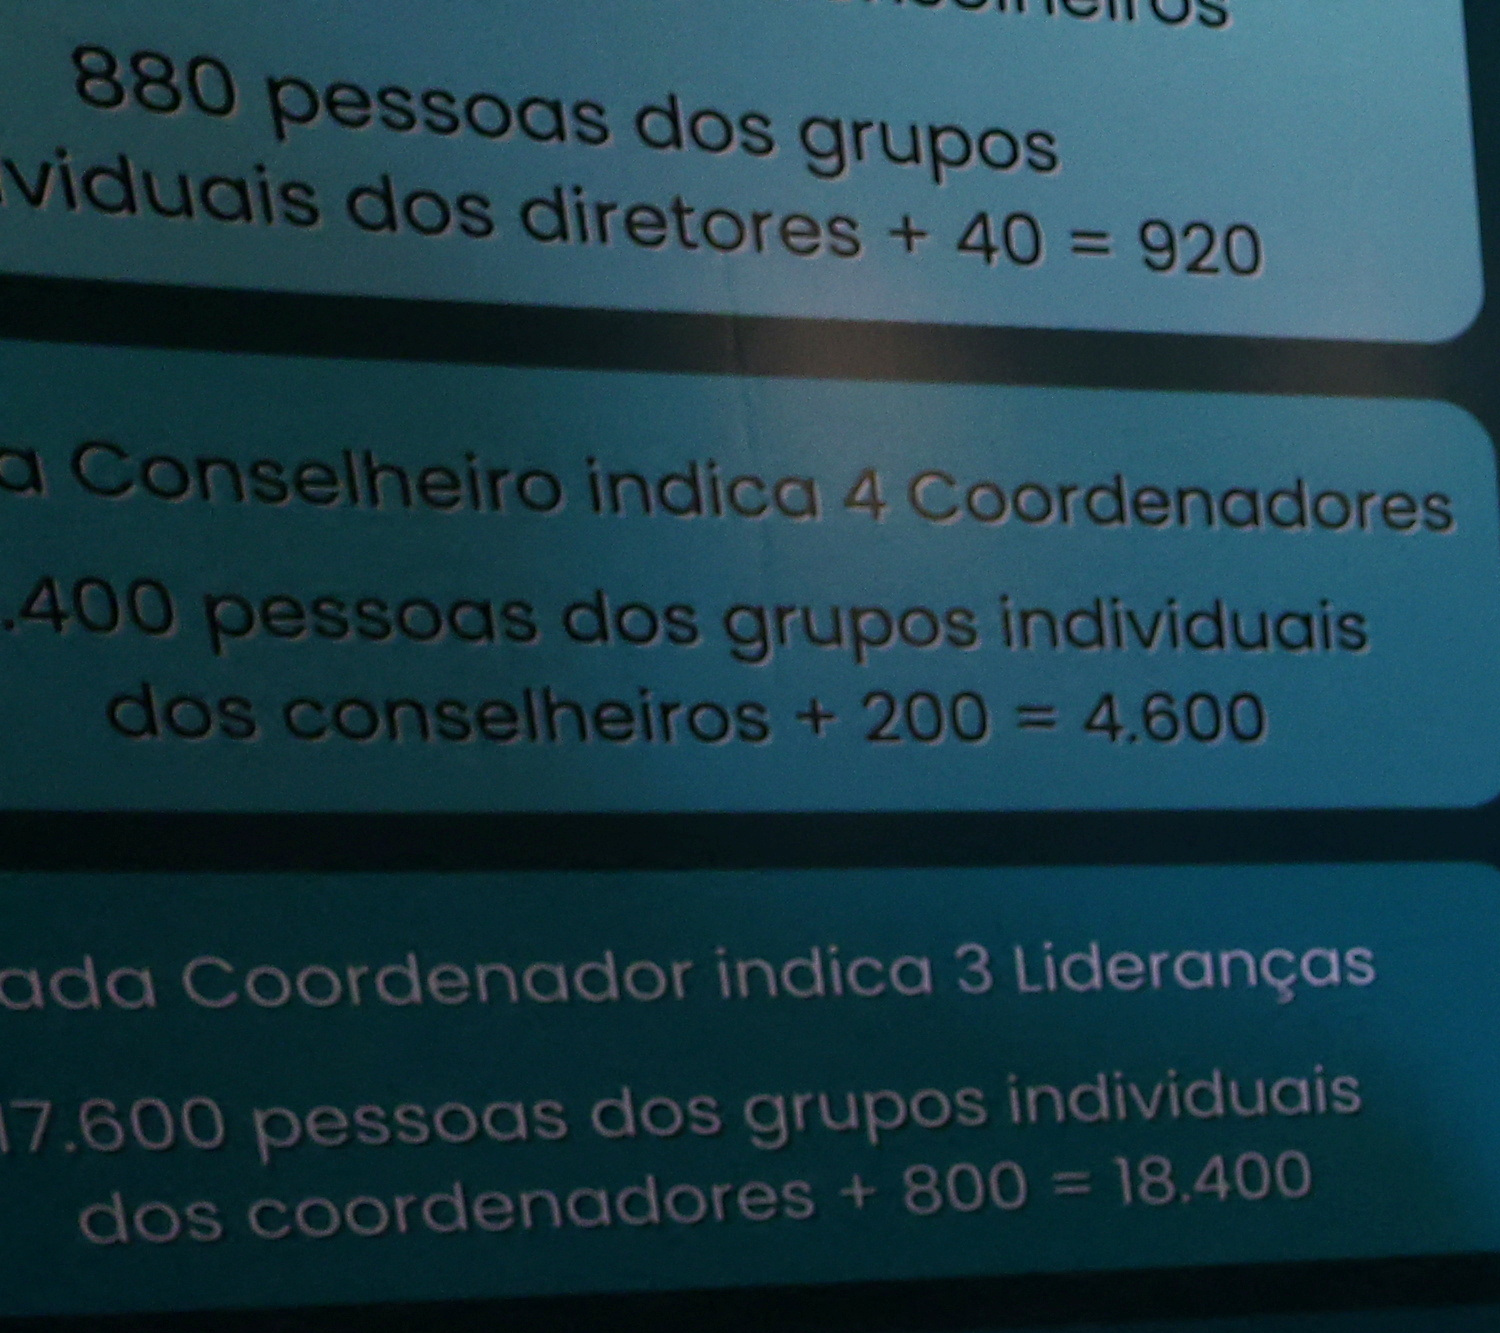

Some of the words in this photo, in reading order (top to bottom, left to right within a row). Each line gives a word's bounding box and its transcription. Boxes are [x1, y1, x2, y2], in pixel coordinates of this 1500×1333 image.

[74, 45, 236, 117] 880
[268, 75, 610, 141] pessoas
[636, 94, 776, 156] dos
[801, 113, 1060, 185] grupos
[0, 147, 320, 227] viduais
[347, 175, 494, 238] dos
[522, 182, 861, 258] diretores
[889, 213, 927, 253] +
[958, 211, 1043, 266] 40
[1072, 228, 1111, 255] =
[1139, 219, 1263, 277] 920
[71, 441, 562, 514] Conselheiro
[587, 456, 822, 524] indica
[843, 467, 885, 521] 4
[907, 468, 1456, 535] Coordenadores
[206, 592, 540, 654] pessoas
[562, 589, 700, 646] dos
[723, 600, 979, 667] grupos
[1001, 595, 1369, 654] individuais
[107, 682, 258, 744] dos
[284, 687, 772, 745] conselheiros
[799, 700, 835, 736] +
[863, 691, 990, 745] 200
[1016, 704, 1058, 729] =
[1084, 691, 1268, 747] 4.600
[0, 954, 157, 1010] ada
[181, 950, 695, 1009] Coordenador
[715, 943, 932, 1000] indica
[955, 943, 993, 995] 3
[1016, 942, 1376, 1003] Lideranças
[253, 1097, 570, 1166] pessoas
[592, 1085, 723, 1140] dos
[744, 1083, 989, 1147] grupos
[1008, 1064, 1364, 1126] individuais
[79, 1190, 224, 1246] dos
[250, 1174, 816, 1242] coordenadores
[840, 1172, 876, 1211] +
[901, 1161, 1028, 1216] 800
[1053, 1168, 1091, 1196] =
[1111, 1150, 1313, 1208] 18.400
